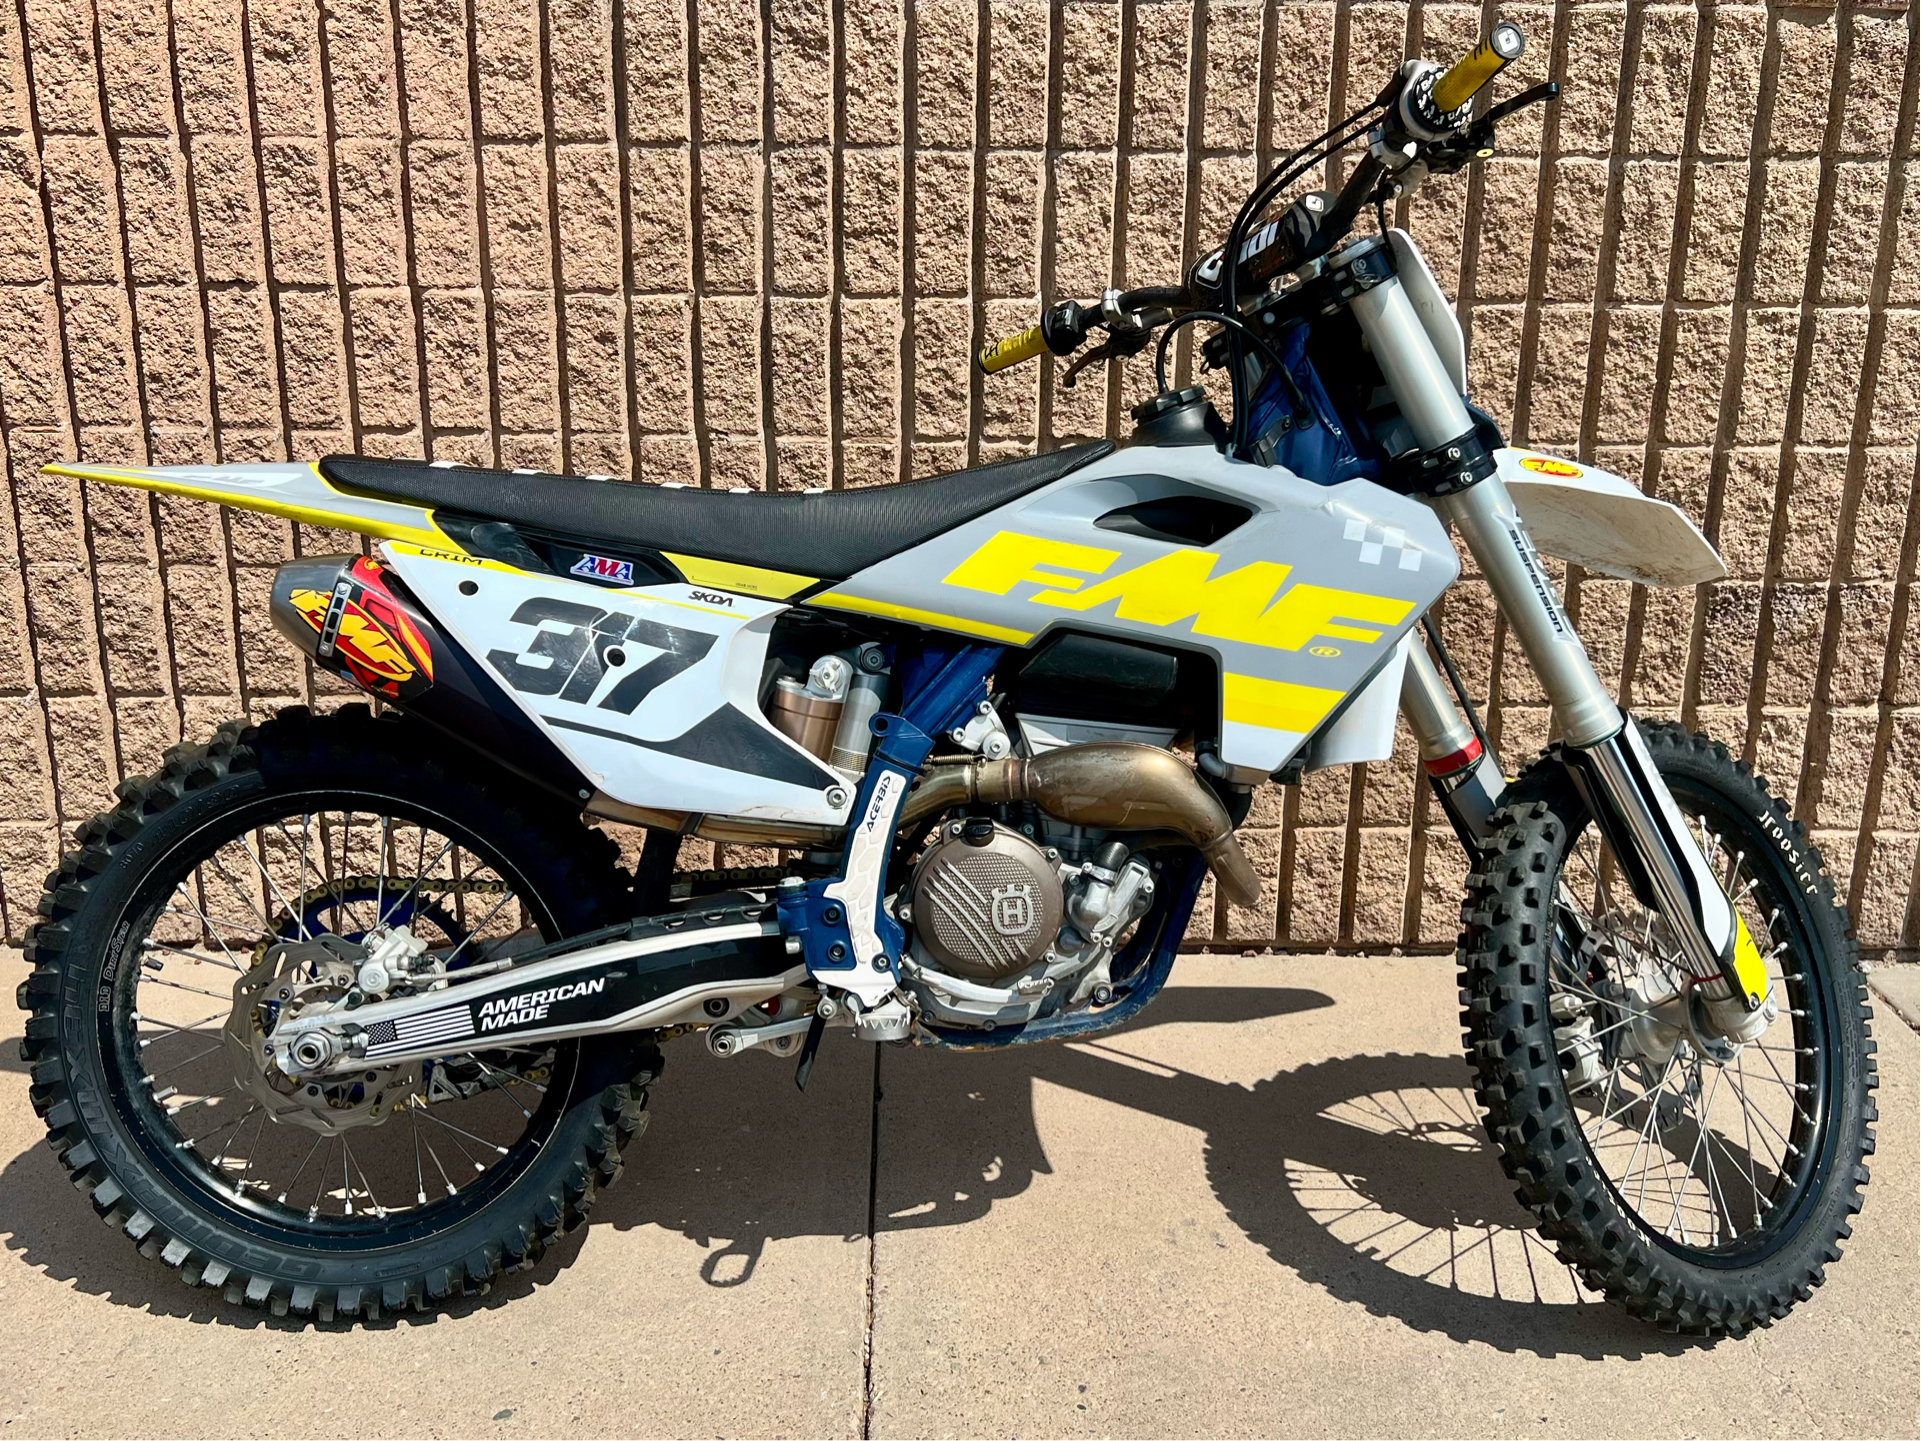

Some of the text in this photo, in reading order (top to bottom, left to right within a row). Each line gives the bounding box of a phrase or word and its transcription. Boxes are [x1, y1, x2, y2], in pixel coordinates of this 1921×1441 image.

[1523, 461, 1579, 477] FMF
[577, 557, 632, 580] AMA
[942, 530, 1416, 652] FMF
[486, 597, 719, 715] 317
[478, 978, 605, 1018] AMERICAN
[481, 1004, 549, 1031] MADE
